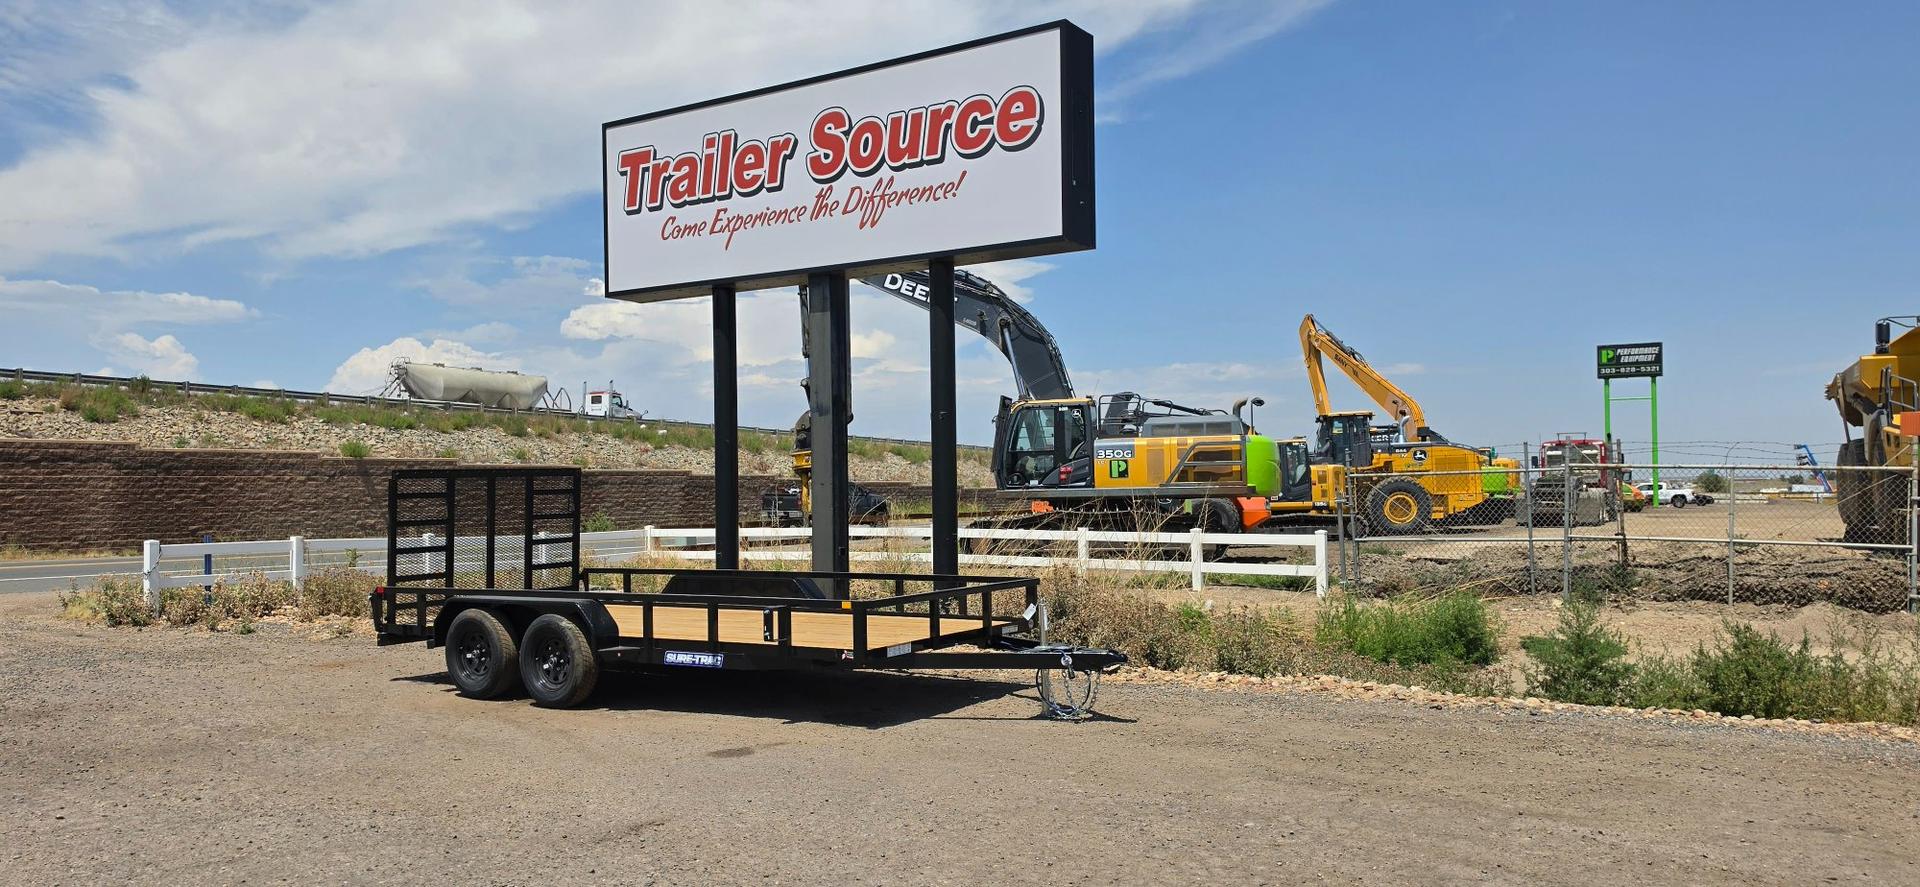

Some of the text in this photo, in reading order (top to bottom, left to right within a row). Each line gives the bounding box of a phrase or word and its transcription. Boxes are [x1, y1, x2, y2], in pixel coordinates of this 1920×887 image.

[618, 86, 1044, 214] Trailer Source
[661, 170, 968, 250] Come Experience the Difference!
[1616, 347, 1659, 355] PERFORMANCE
[1620, 354, 1656, 362] EQUIPMENT
[1097, 449, 1132, 459] 350G
[666, 653, 721, 665] SURE-TRAC
